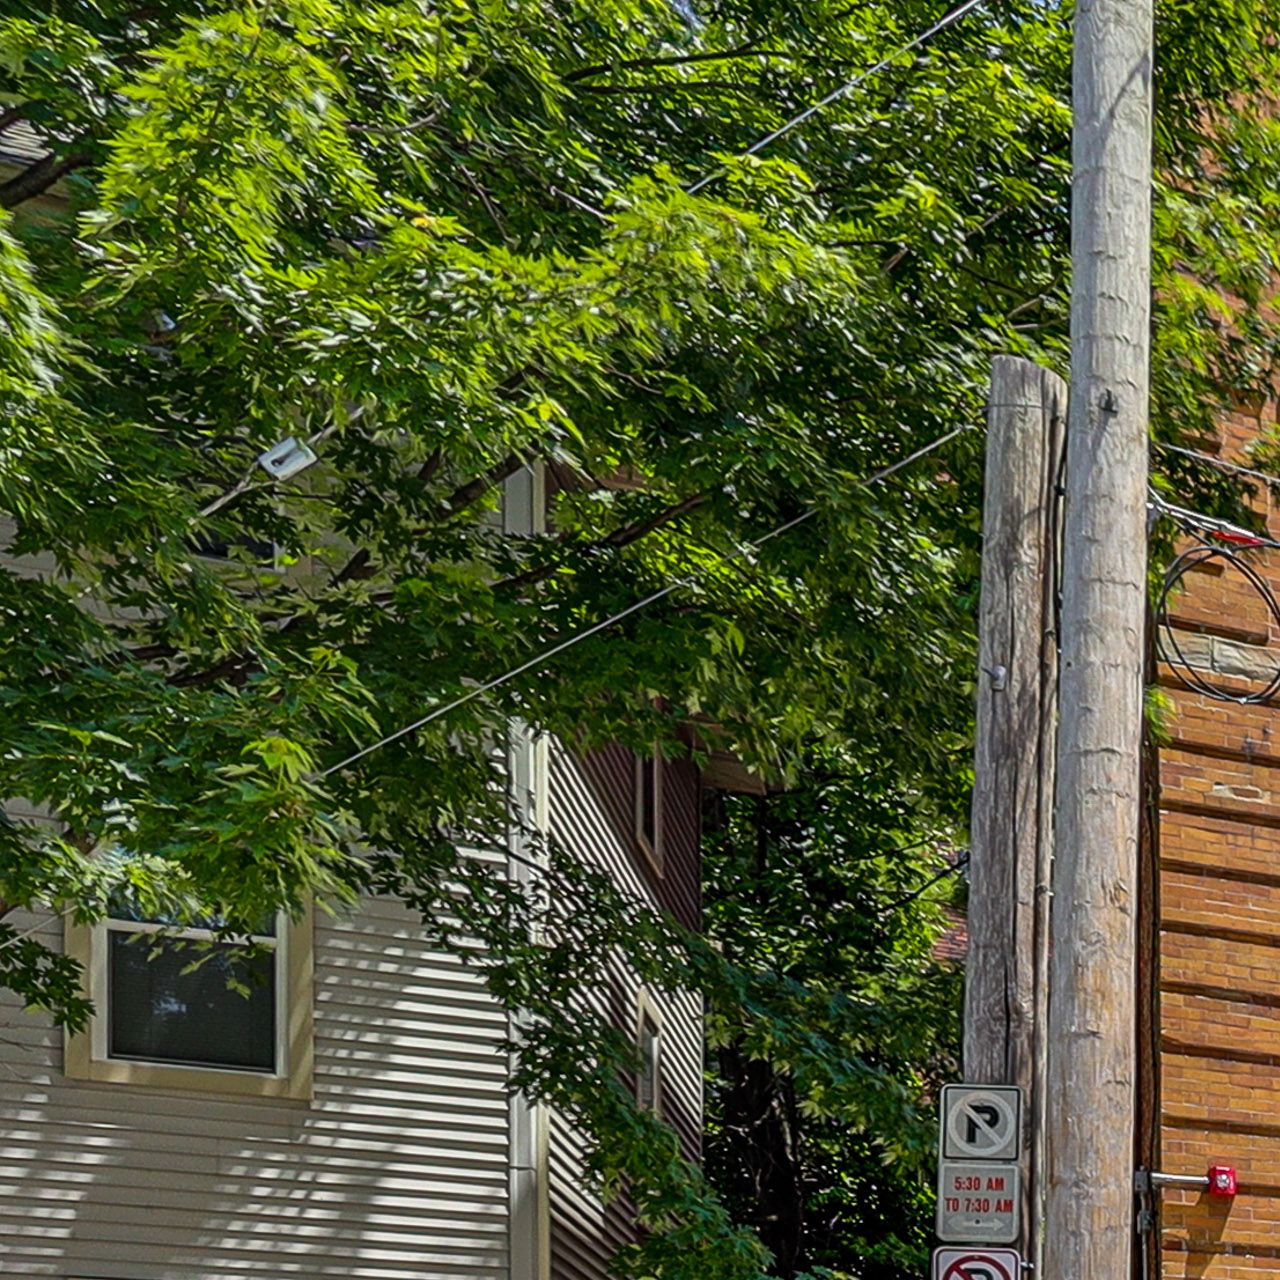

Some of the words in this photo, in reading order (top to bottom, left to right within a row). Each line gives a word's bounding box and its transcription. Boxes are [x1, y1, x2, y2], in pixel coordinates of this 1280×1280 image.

[954, 1176, 981, 1191] 5:30
[986, 1177, 1005, 1191] AM
[944, 1197, 960, 1212] TO
[964, 1198, 990, 1213] 7:30
[995, 1199, 1014, 1213] AM
